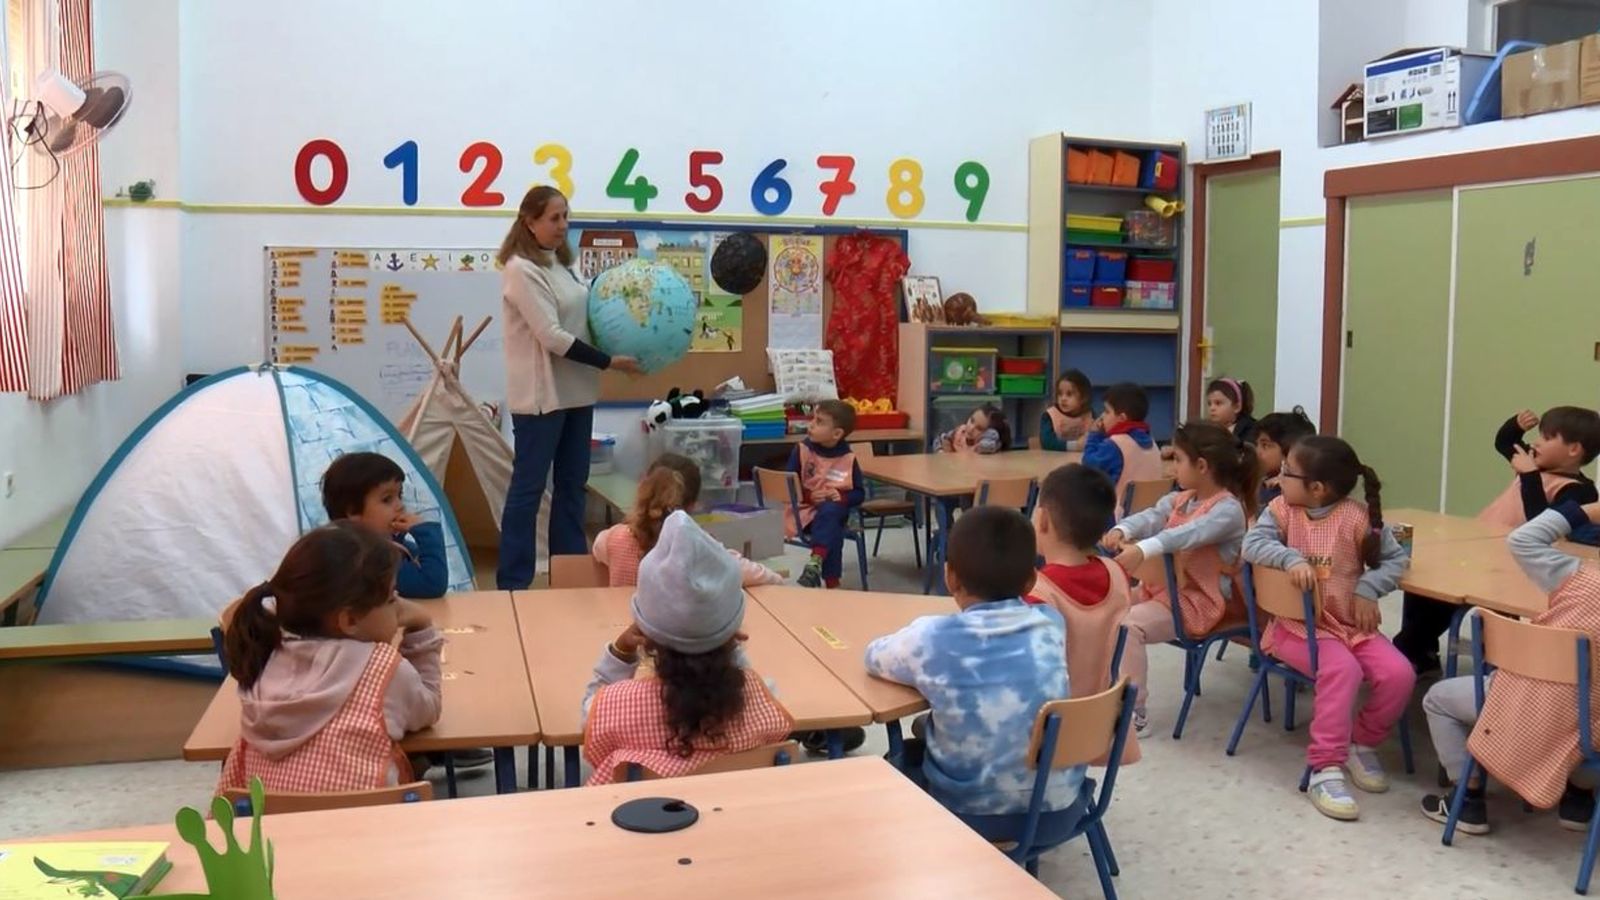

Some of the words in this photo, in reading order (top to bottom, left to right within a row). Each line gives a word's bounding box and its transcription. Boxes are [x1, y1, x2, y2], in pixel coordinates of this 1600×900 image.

[295, 139, 348, 205] 0
[384, 140, 418, 206] 1
[460, 141, 504, 207] 2
[531, 143, 574, 200] 3
[606, 148, 658, 212] 4
[685, 151, 723, 213] 5
[751, 158, 793, 216] 6
[817, 155, 856, 216] 7
[886, 158, 925, 218] 8
[954, 161, 989, 222] 9
[374, 252, 382, 262] A
